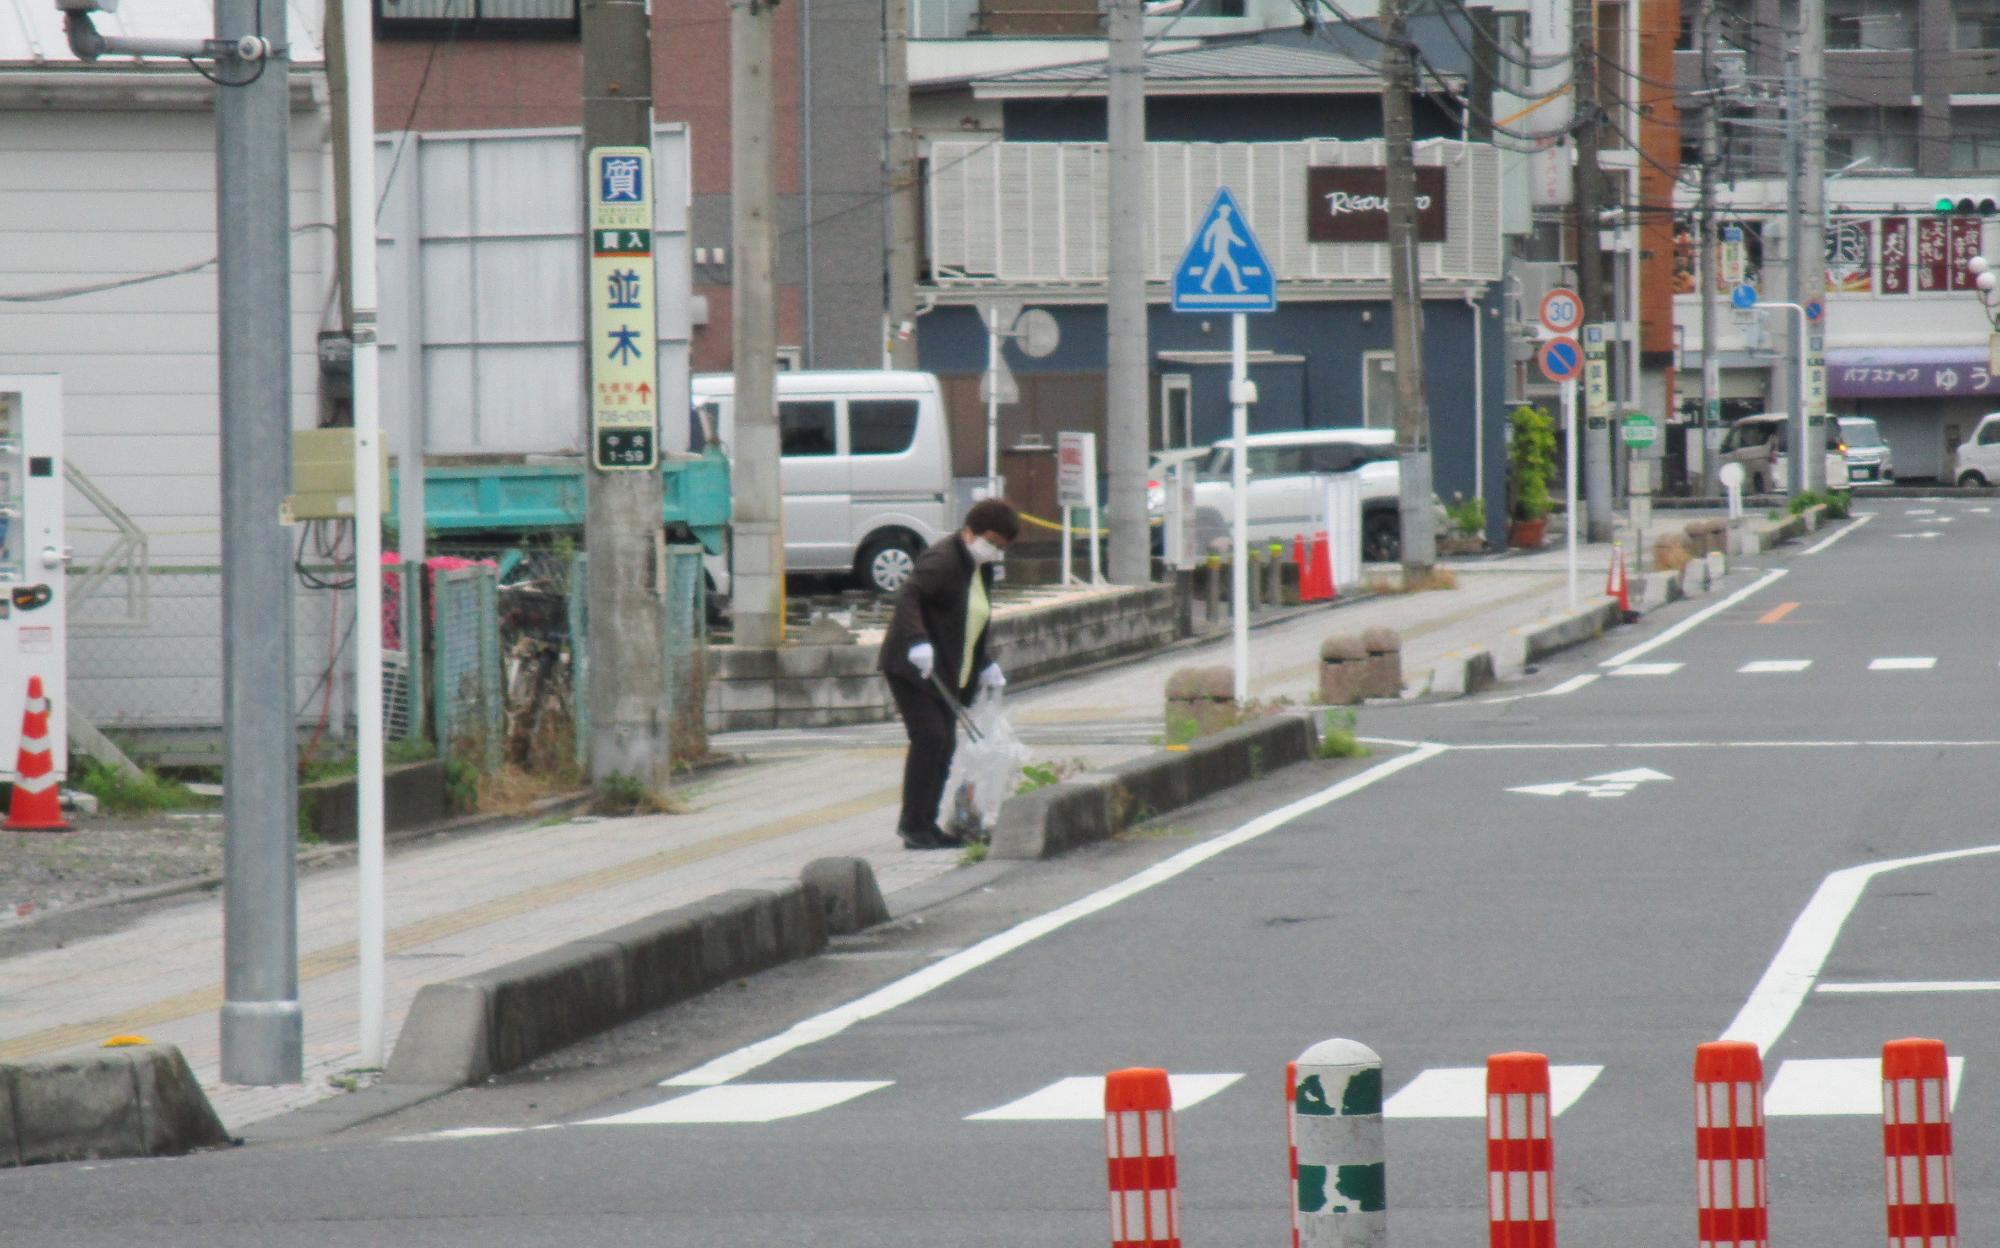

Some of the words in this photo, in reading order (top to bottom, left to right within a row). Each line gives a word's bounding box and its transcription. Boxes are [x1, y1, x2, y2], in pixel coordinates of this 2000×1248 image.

[606, 159, 639, 199] 質
[607, 269, 641, 365] 並木
[1550, 302, 1575, 321] 30
[1936, 367, 1990, 390] ゆう
[609, 450, 646, 462] 1-59
